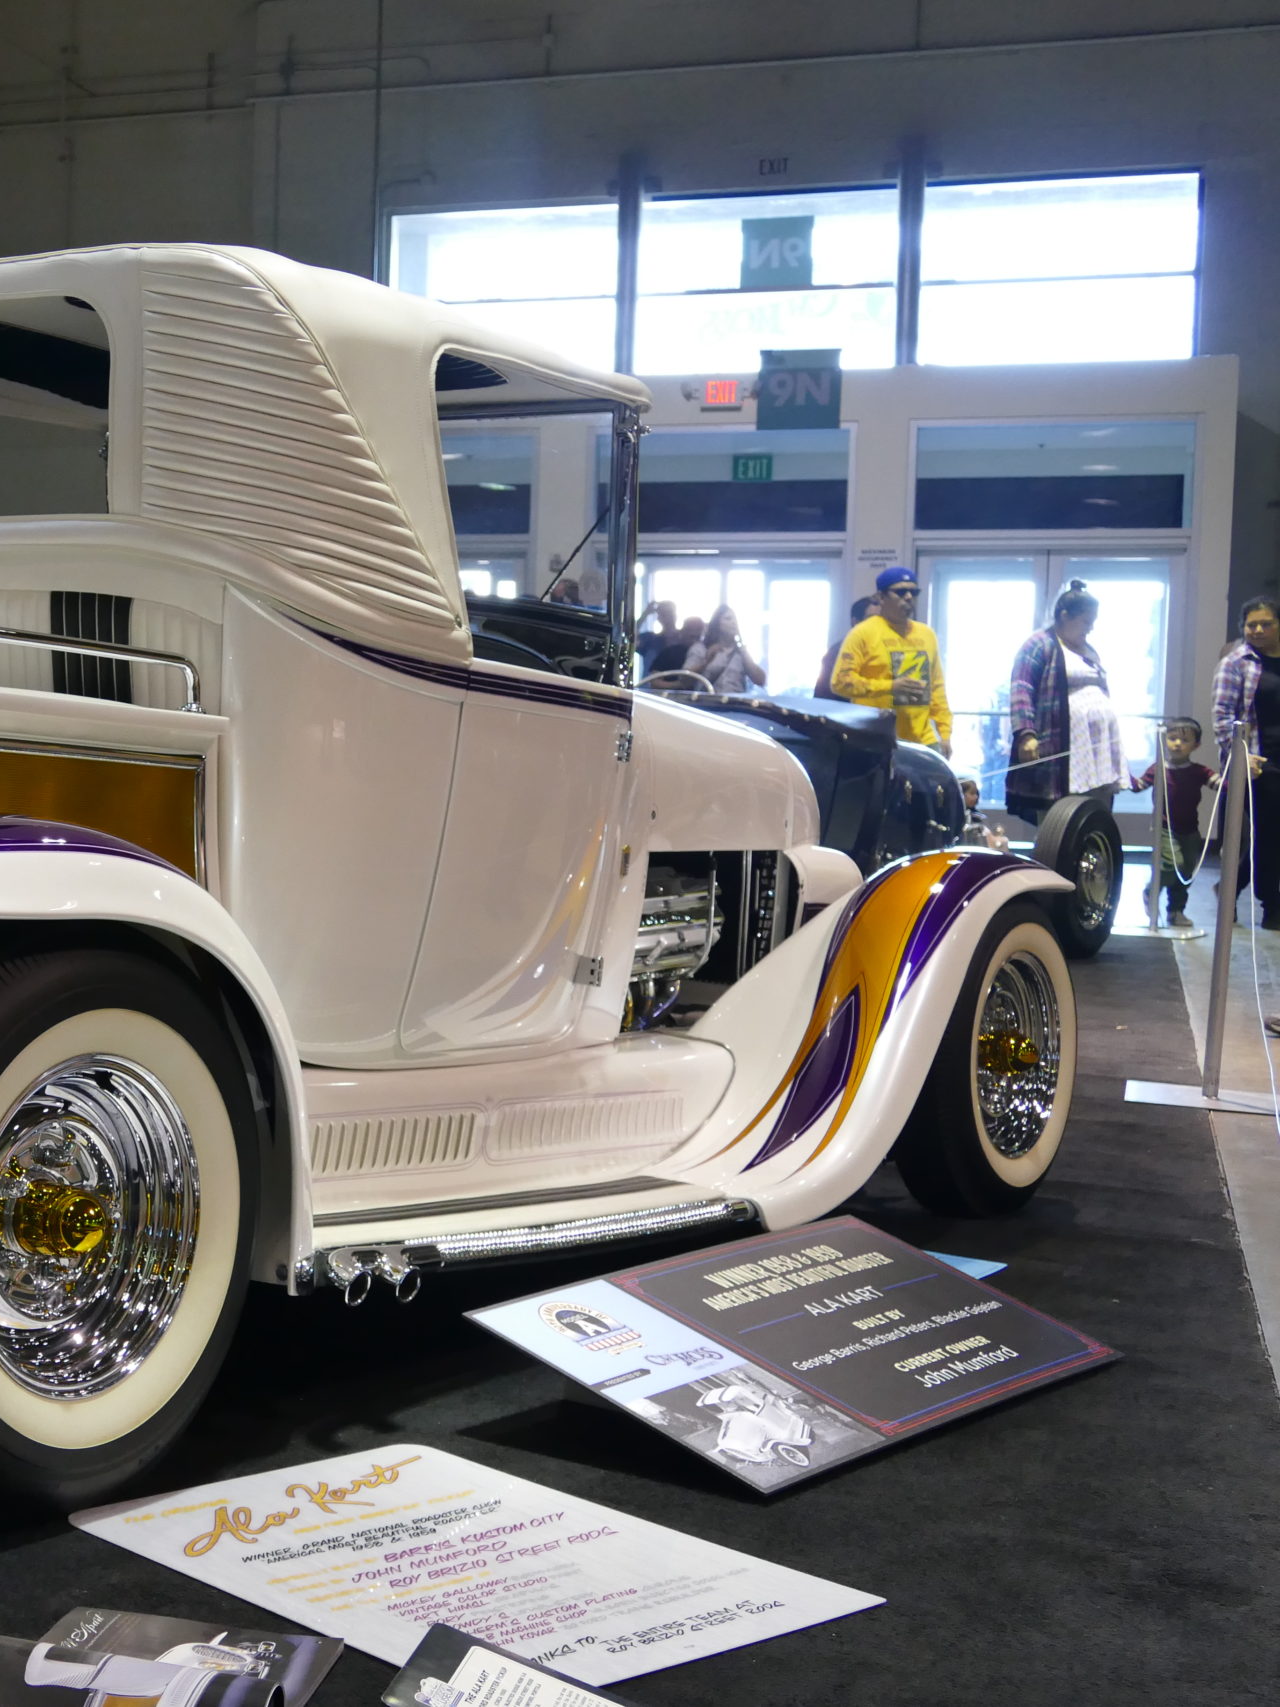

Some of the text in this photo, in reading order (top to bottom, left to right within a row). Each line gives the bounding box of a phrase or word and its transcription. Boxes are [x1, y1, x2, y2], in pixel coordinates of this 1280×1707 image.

[760, 158, 789, 176] EXIT
[706, 380, 738, 404] EXIT
[770, 371, 833, 407] 9N
[737, 458, 768, 479] EXIT
[703, 1263, 772, 1289] WINNER
[758, 1254, 803, 1274] 1958
[801, 1244, 843, 1263] 1959
[703, 1251, 894, 1311] AMERICA'S MOST BEAUTIFUL ROADSTER
[804, 1285, 884, 1317] ALA KART
[852, 1308, 906, 1330] BUILT BY
[792, 1354, 836, 1371] George
[830, 1342, 870, 1359] Barris,
[862, 1326, 905, 1348] Richard
[899, 1317, 939, 1335] Peters,
[930, 1310, 970, 1325] Blackie
[893, 1335, 992, 1372] CURRENT OWNER
[915, 1344, 1020, 1388] John Mumford
[183, 1506, 300, 1557] Ala
[285, 1455, 423, 1514] Kart
[241, 1547, 291, 1563] WINNER
[302, 1536, 345, 1550] GRAND
[351, 1522, 408, 1538] NATIONAL
[412, 1507, 467, 1524] ROADSTER
[328, 1539, 359, 1551] MOST
[364, 1525, 428, 1542] BEAUTIFUL
[408, 1528, 437, 1539] 1959
[460, 1522, 528, 1545] KUSTOM
[530, 1511, 566, 1528] CITY
[351, 1564, 402, 1584] JOHN
[409, 1540, 507, 1569] MUMFORD
[389, 1573, 421, 1589] ROY
[427, 1558, 487, 1580] BRIZIO
[495, 1539, 562, 1564] STREET
[567, 1525, 620, 1545] RODS
[387, 1594, 437, 1611] MICKEY
[442, 1577, 508, 1599] GALLOWAY
[399, 1600, 452, 1617] VINTAGE
[457, 1588, 497, 1604] COLOR
[502, 1576, 548, 1593] STUDIO
[526, 1603, 579, 1621] CUSTOM
[584, 1587, 638, 1606] PLATING
[413, 1610, 440, 1622] ART
[500, 1619, 552, 1637] MACHINE
[556, 1608, 588, 1623] SHOP
[599, 1635, 632, 1647] THE
[632, 1620, 686, 1639] ENTIRE
[684, 1607, 733, 1622] TEAM
[735, 1599, 756, 1611] AT
[606, 1600, 786, 1654] ROY BRIZIO STREET RODS
[464, 1669, 490, 1705] THE ALA KART
